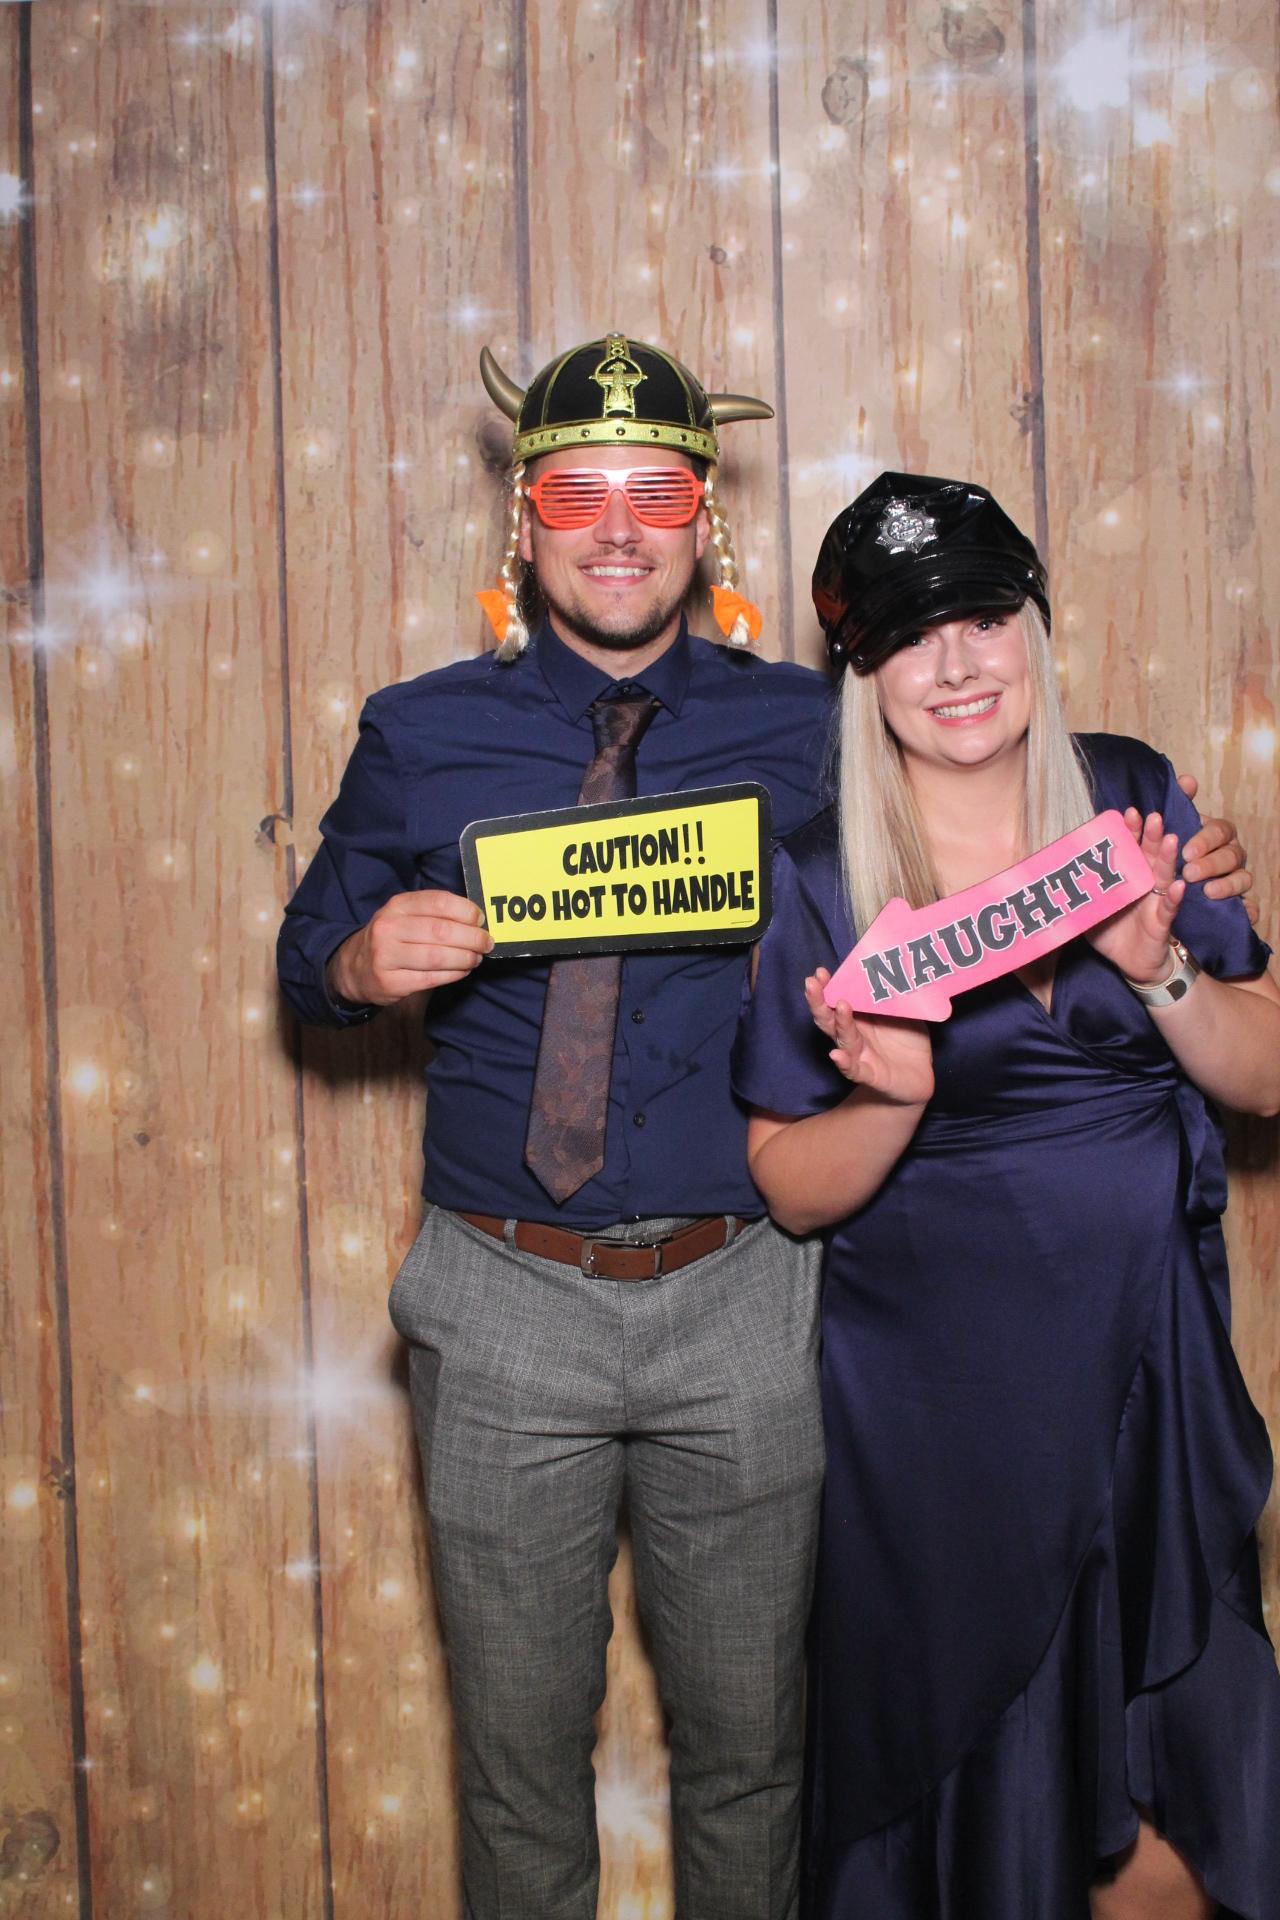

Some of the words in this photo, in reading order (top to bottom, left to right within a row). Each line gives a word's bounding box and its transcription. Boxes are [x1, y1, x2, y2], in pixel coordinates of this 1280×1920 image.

[562, 820, 706, 876] CAUTION!!
[491, 893, 547, 923] TOO
[552, 885, 606, 921] HOT
[611, 883, 647, 916] TO
[652, 870, 755, 916] HANDLE
[860, 836, 1124, 1004] NAUGHTY
